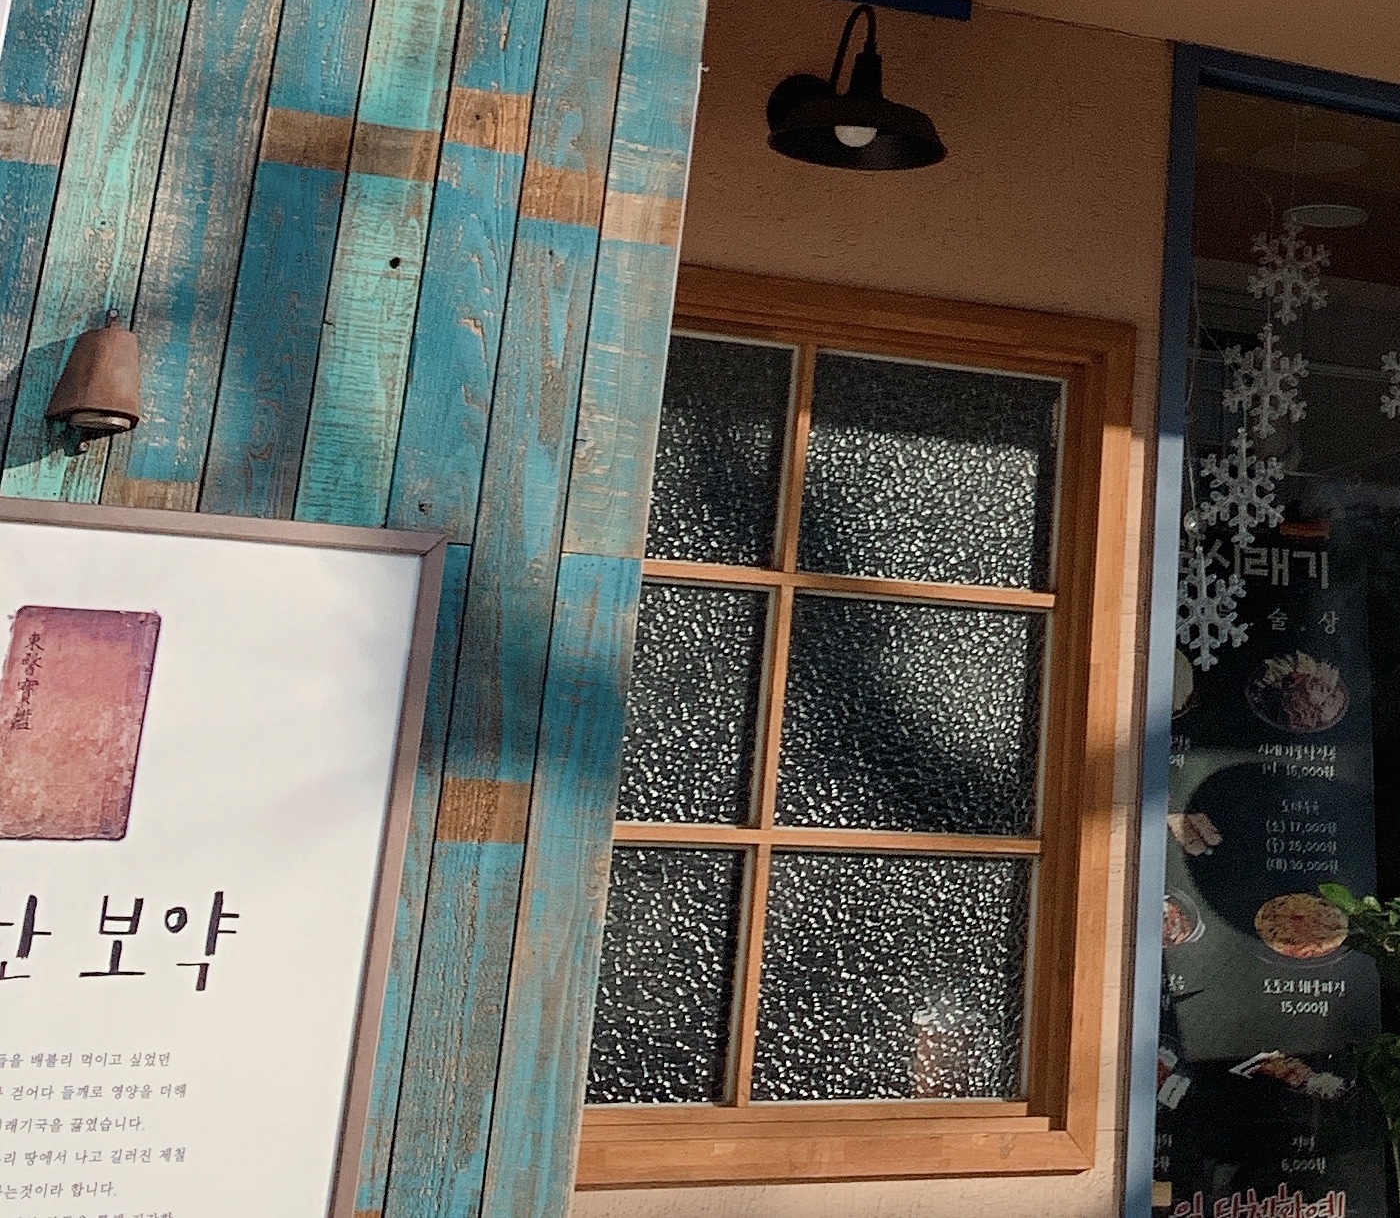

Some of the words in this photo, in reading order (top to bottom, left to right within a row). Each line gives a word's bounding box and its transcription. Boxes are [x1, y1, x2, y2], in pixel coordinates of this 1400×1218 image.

[78, 890, 240, 991] 보약
[1280, 1001, 1329, 1017] 15,000원
[30, 1052, 73, 1069] 배불리
[81, 1051, 123, 1068] 먹이고
[129, 1051, 171, 1068] 싶었던
[61, 1085, 104, 1100] 들깨로
[111, 1084, 153, 1100] 영양을
[159, 1083, 187, 1099] 더해
[0, 1118, 63, 1133] 래기국을
[70, 1116, 146, 1133] 끓였습니다.
[0, 1151, 17, 1167] 리
[24, 1149, 67, 1166] 땅에서
[75, 1149, 103, 1165] 나고
[109, 1148, 152, 1164] 길러진
[159, 1147, 187, 1163] 제철
[0, 1183, 64, 1200] 는것이라
[71, 1181, 118, 1198] 합니다.
